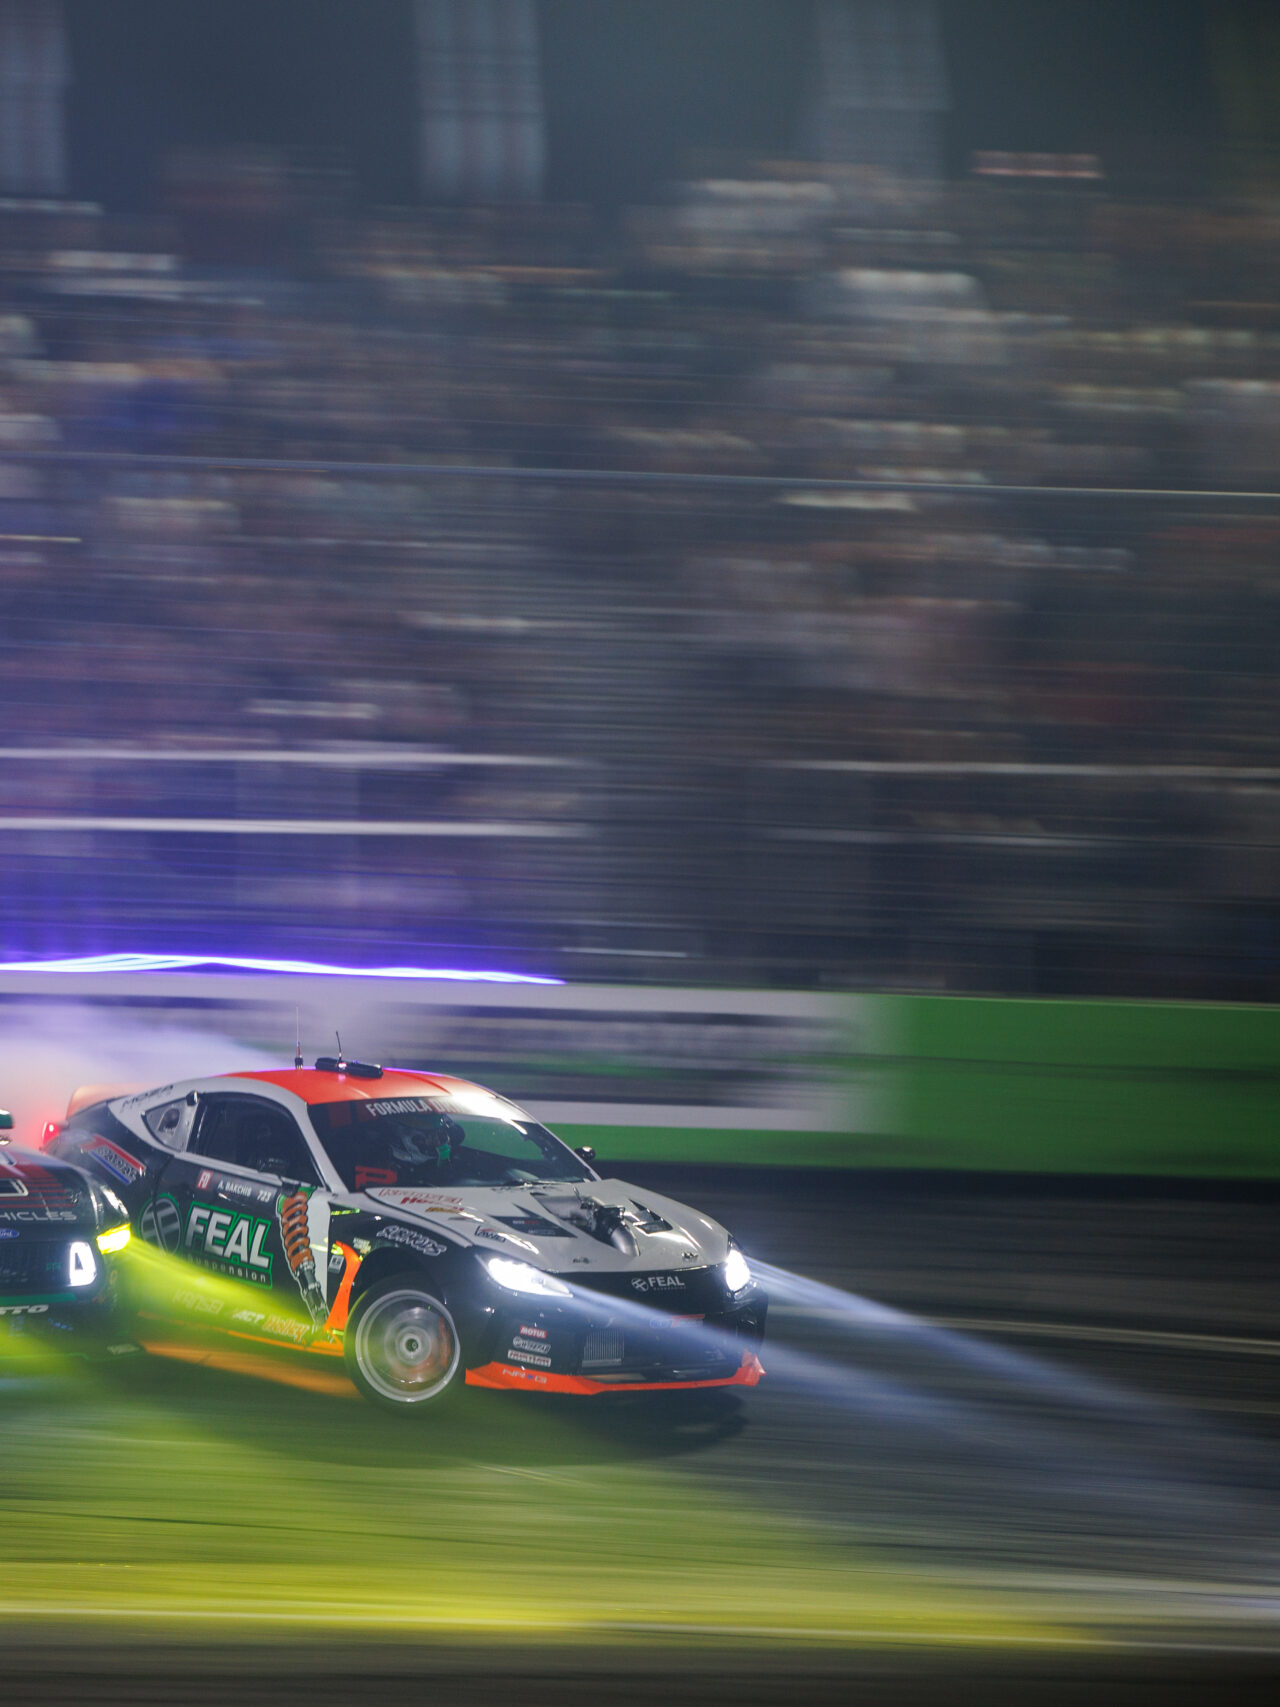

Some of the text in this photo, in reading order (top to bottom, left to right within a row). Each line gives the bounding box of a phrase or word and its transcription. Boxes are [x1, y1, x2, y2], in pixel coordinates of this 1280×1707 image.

[365, 1099, 432, 1117] FORMULA
[185, 1206, 270, 1269] FEAL
[647, 1275, 685, 1287] FEAL
[520, 1327, 546, 1338] MOTUL
